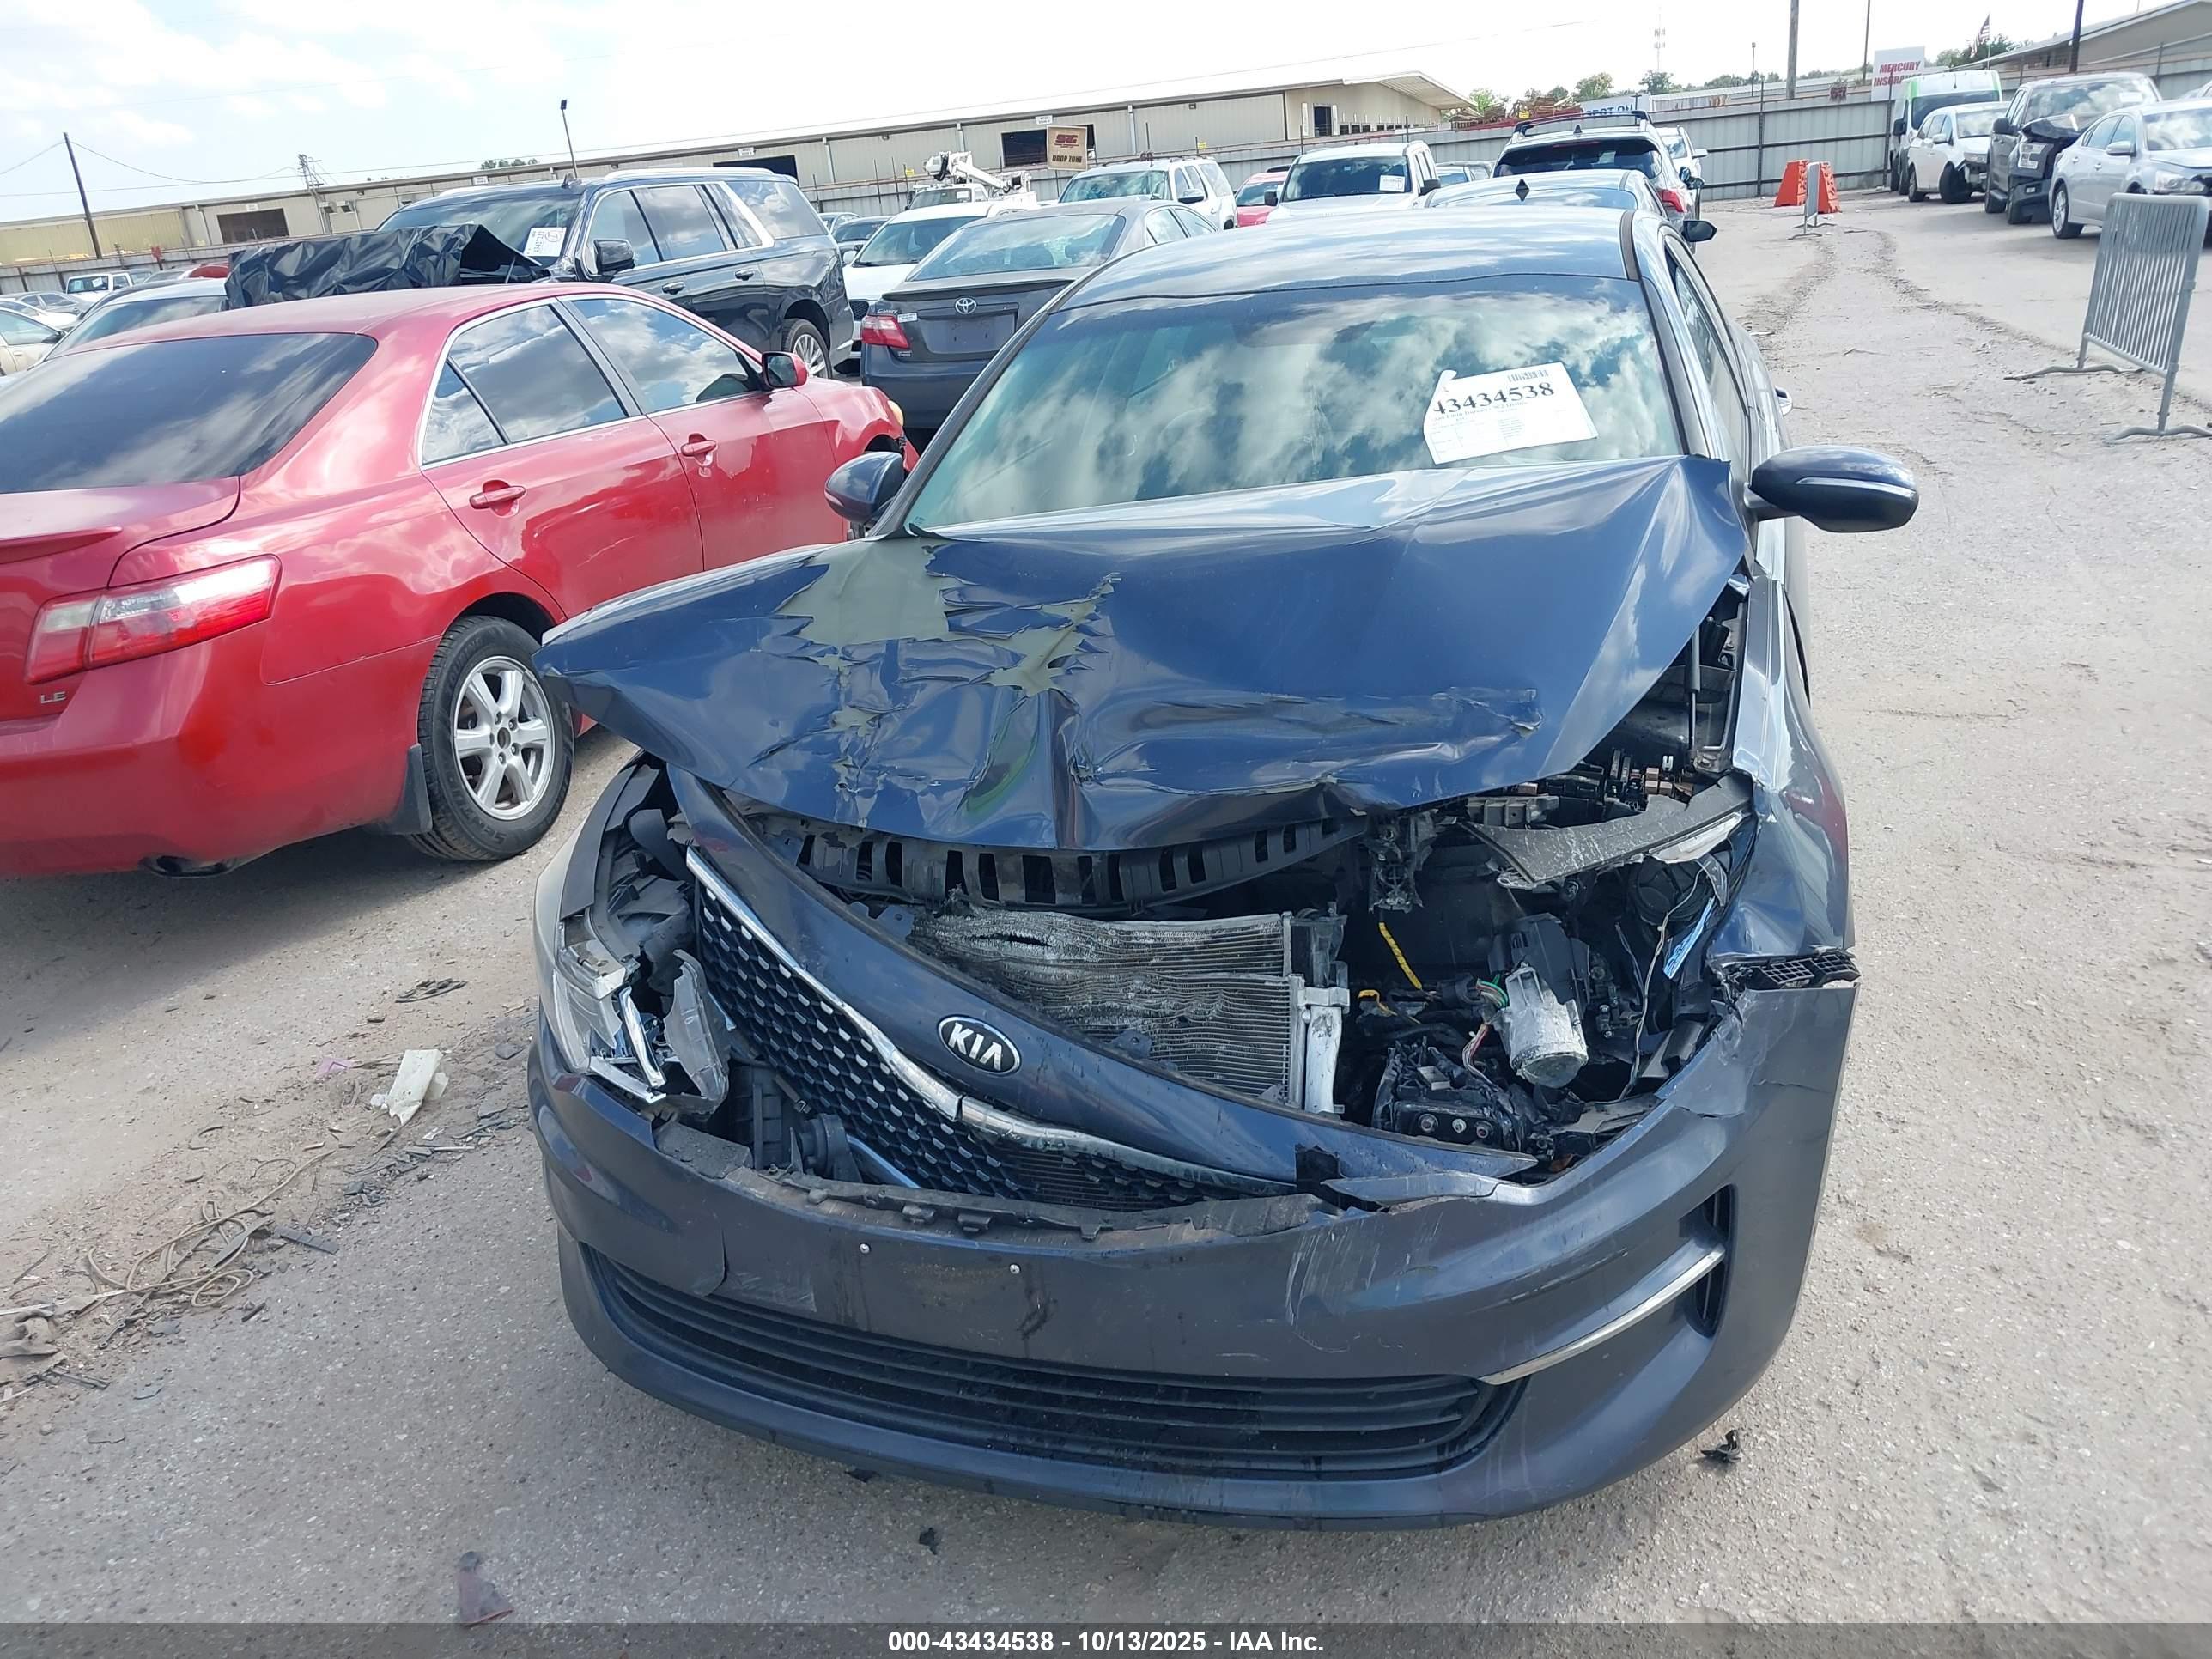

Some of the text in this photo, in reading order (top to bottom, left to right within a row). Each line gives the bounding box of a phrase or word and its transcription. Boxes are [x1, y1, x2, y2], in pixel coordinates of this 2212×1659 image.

[1879, 61, 1921, 73] MERCURY
[1874, 73, 1922, 87] INSURA
[1433, 382, 1554, 415] 43434538
[40, 691, 66, 704] LE
[948, 1022, 1002, 1072] KIA
